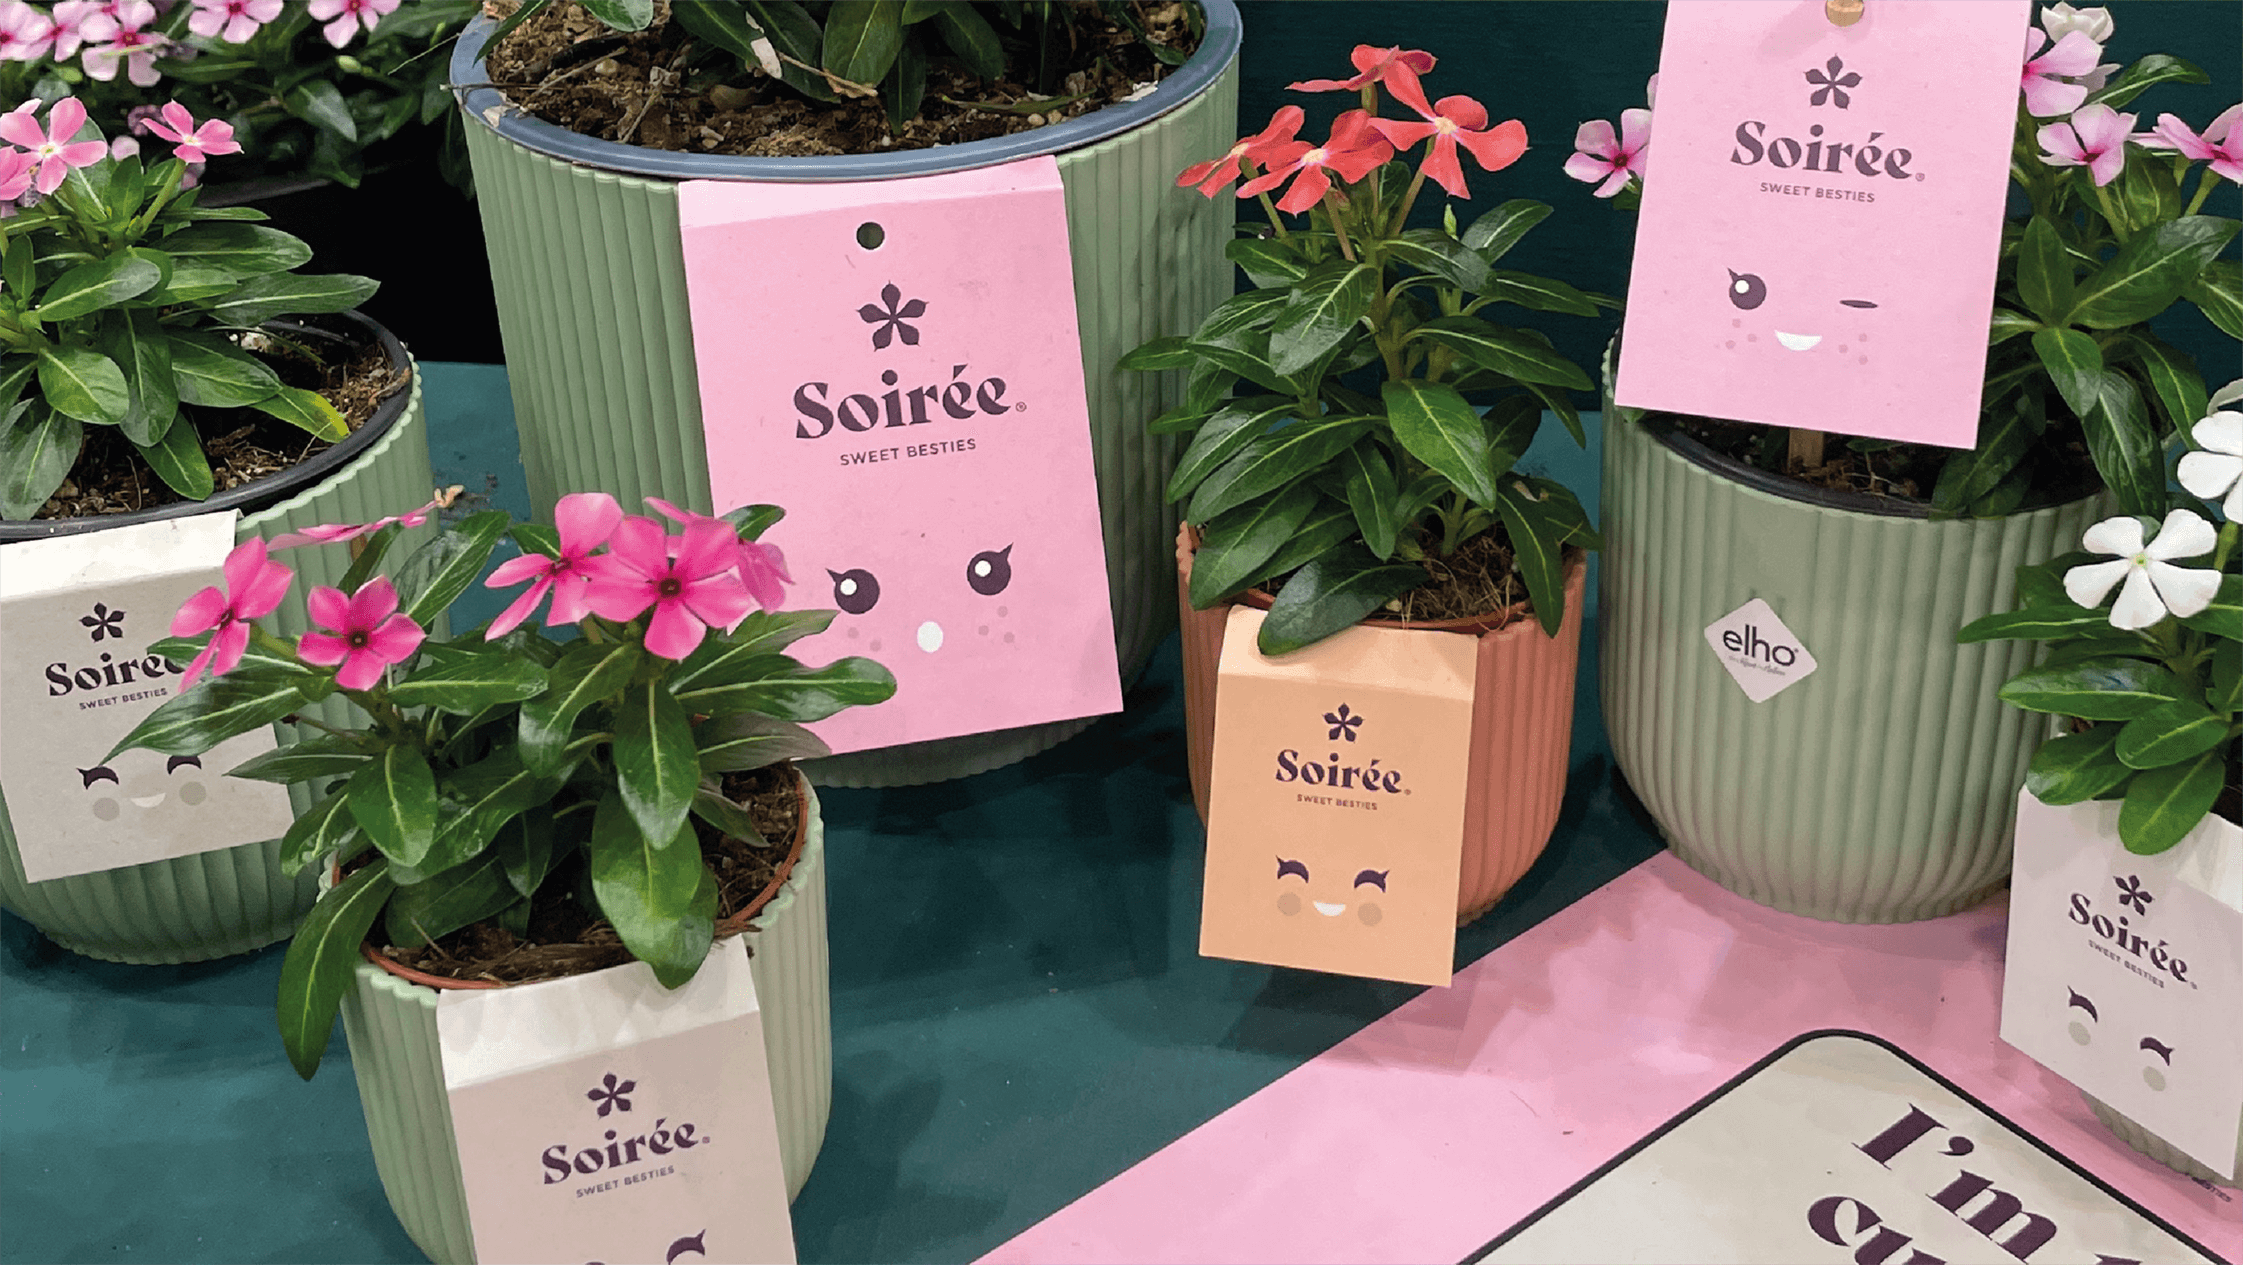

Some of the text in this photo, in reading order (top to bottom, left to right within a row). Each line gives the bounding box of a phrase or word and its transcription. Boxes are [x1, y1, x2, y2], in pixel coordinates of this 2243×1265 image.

[1760, 182, 1876, 203] SWEET BESTIES
[840, 438, 977, 466] SWEET BESTIES
[1723, 624, 1796, 667] elho
[79, 687, 168, 711] SWEET BESTIES
[1297, 793, 1378, 811] SWEET BESTIES
[576, 1165, 675, 1199] SWEET BESTIES
[1852, 1103, 2057, 1265] I'm
